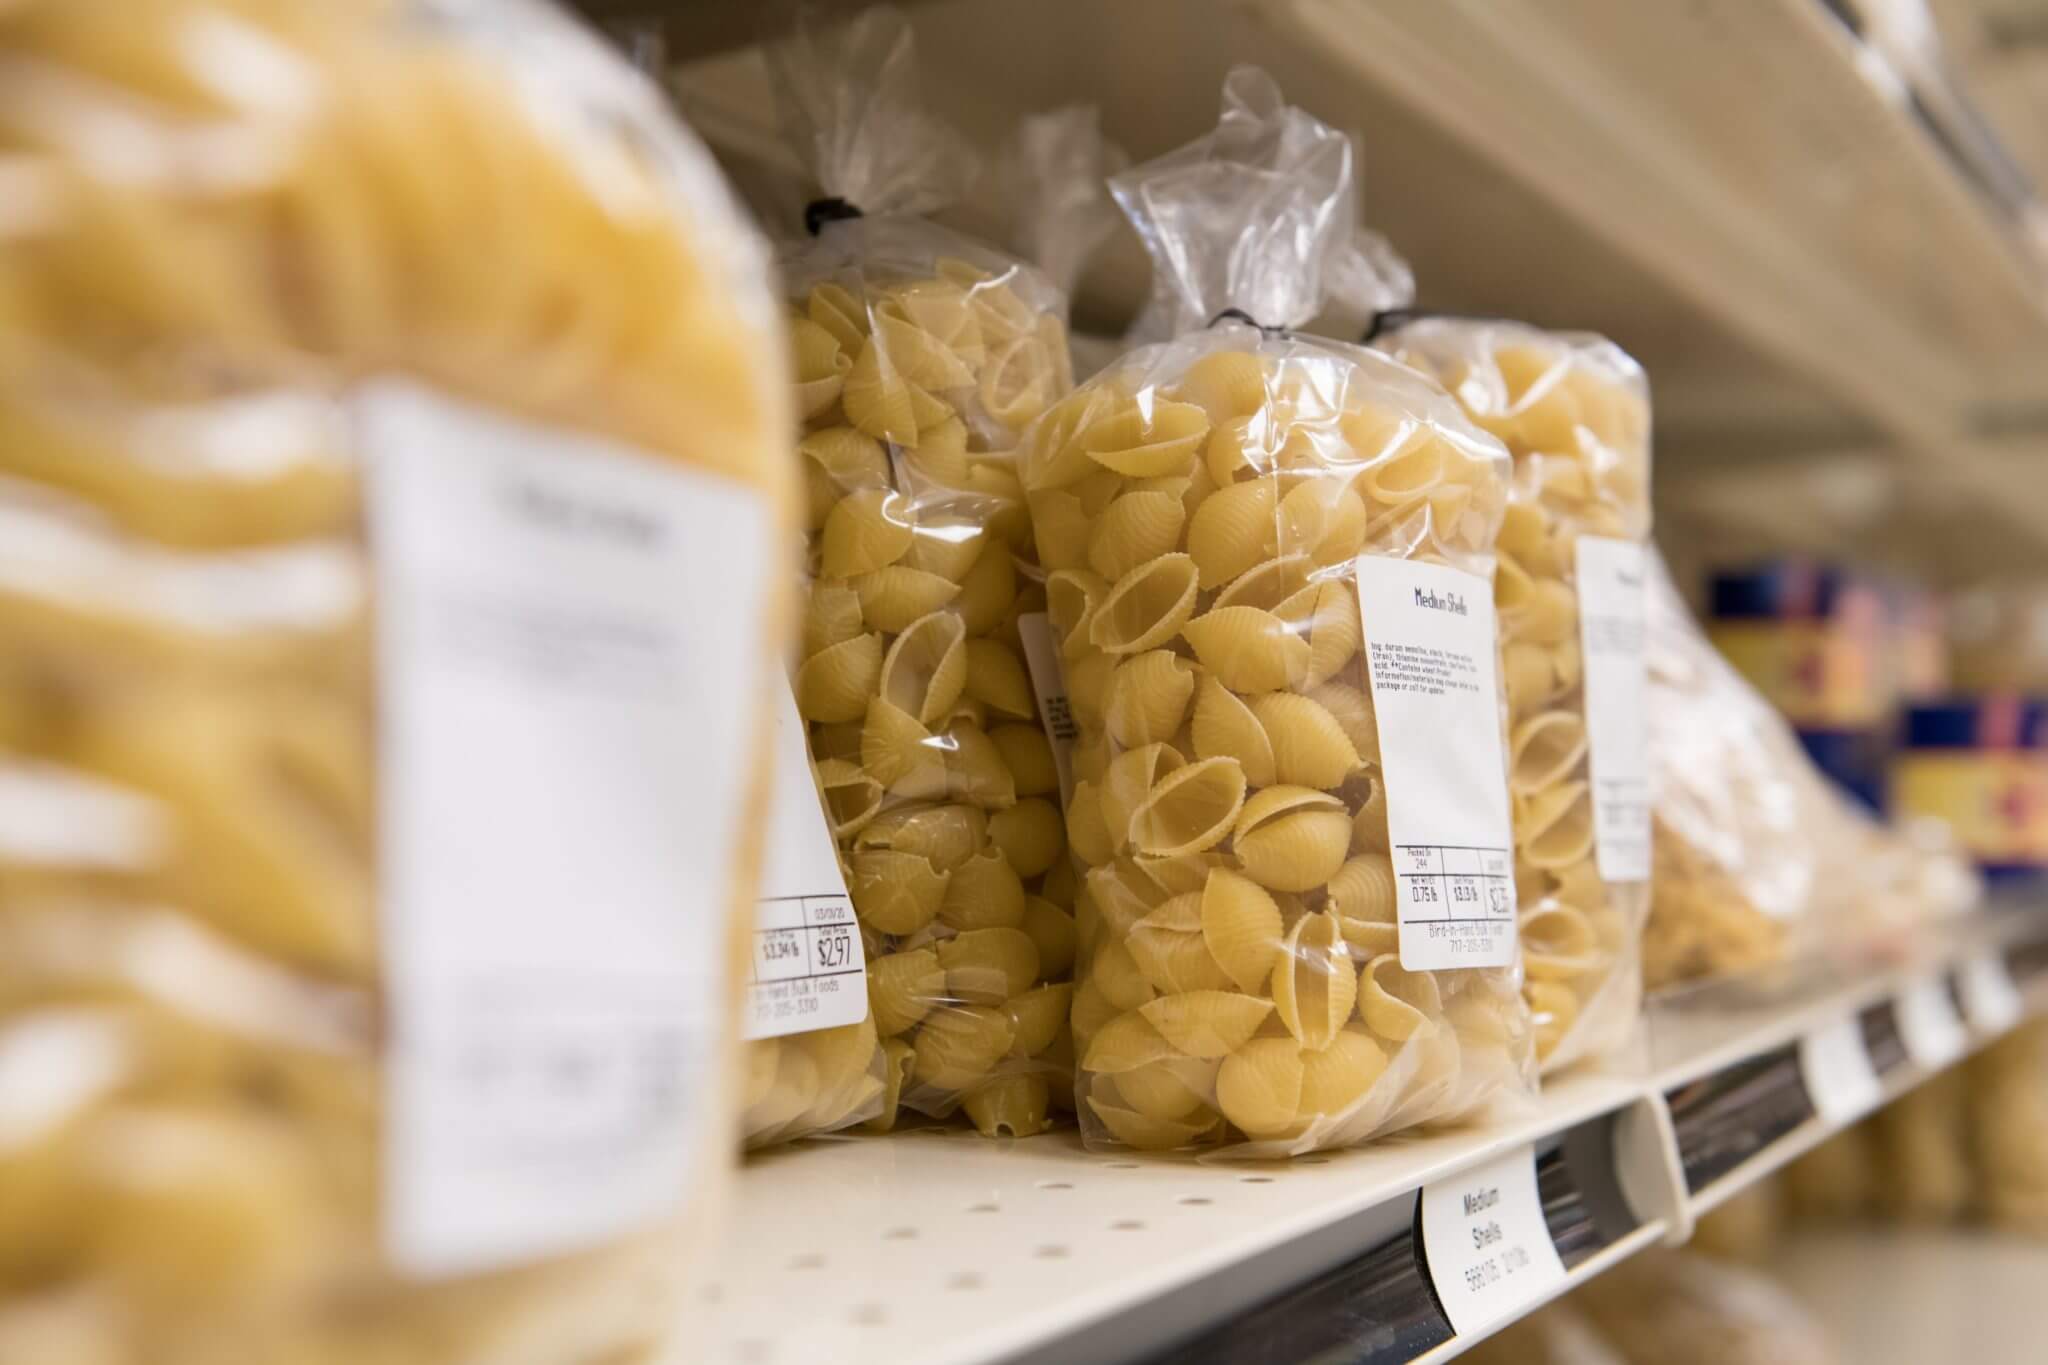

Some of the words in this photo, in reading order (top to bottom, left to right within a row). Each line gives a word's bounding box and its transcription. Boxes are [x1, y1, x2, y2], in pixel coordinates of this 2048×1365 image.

[1414, 586, 1446, 610] Medium
[1447, 592, 1467, 616] Shells
[814, 976, 840, 994] Foods
[1463, 1187, 1499, 1216] Medium
[1472, 1221, 1502, 1250] Shells
